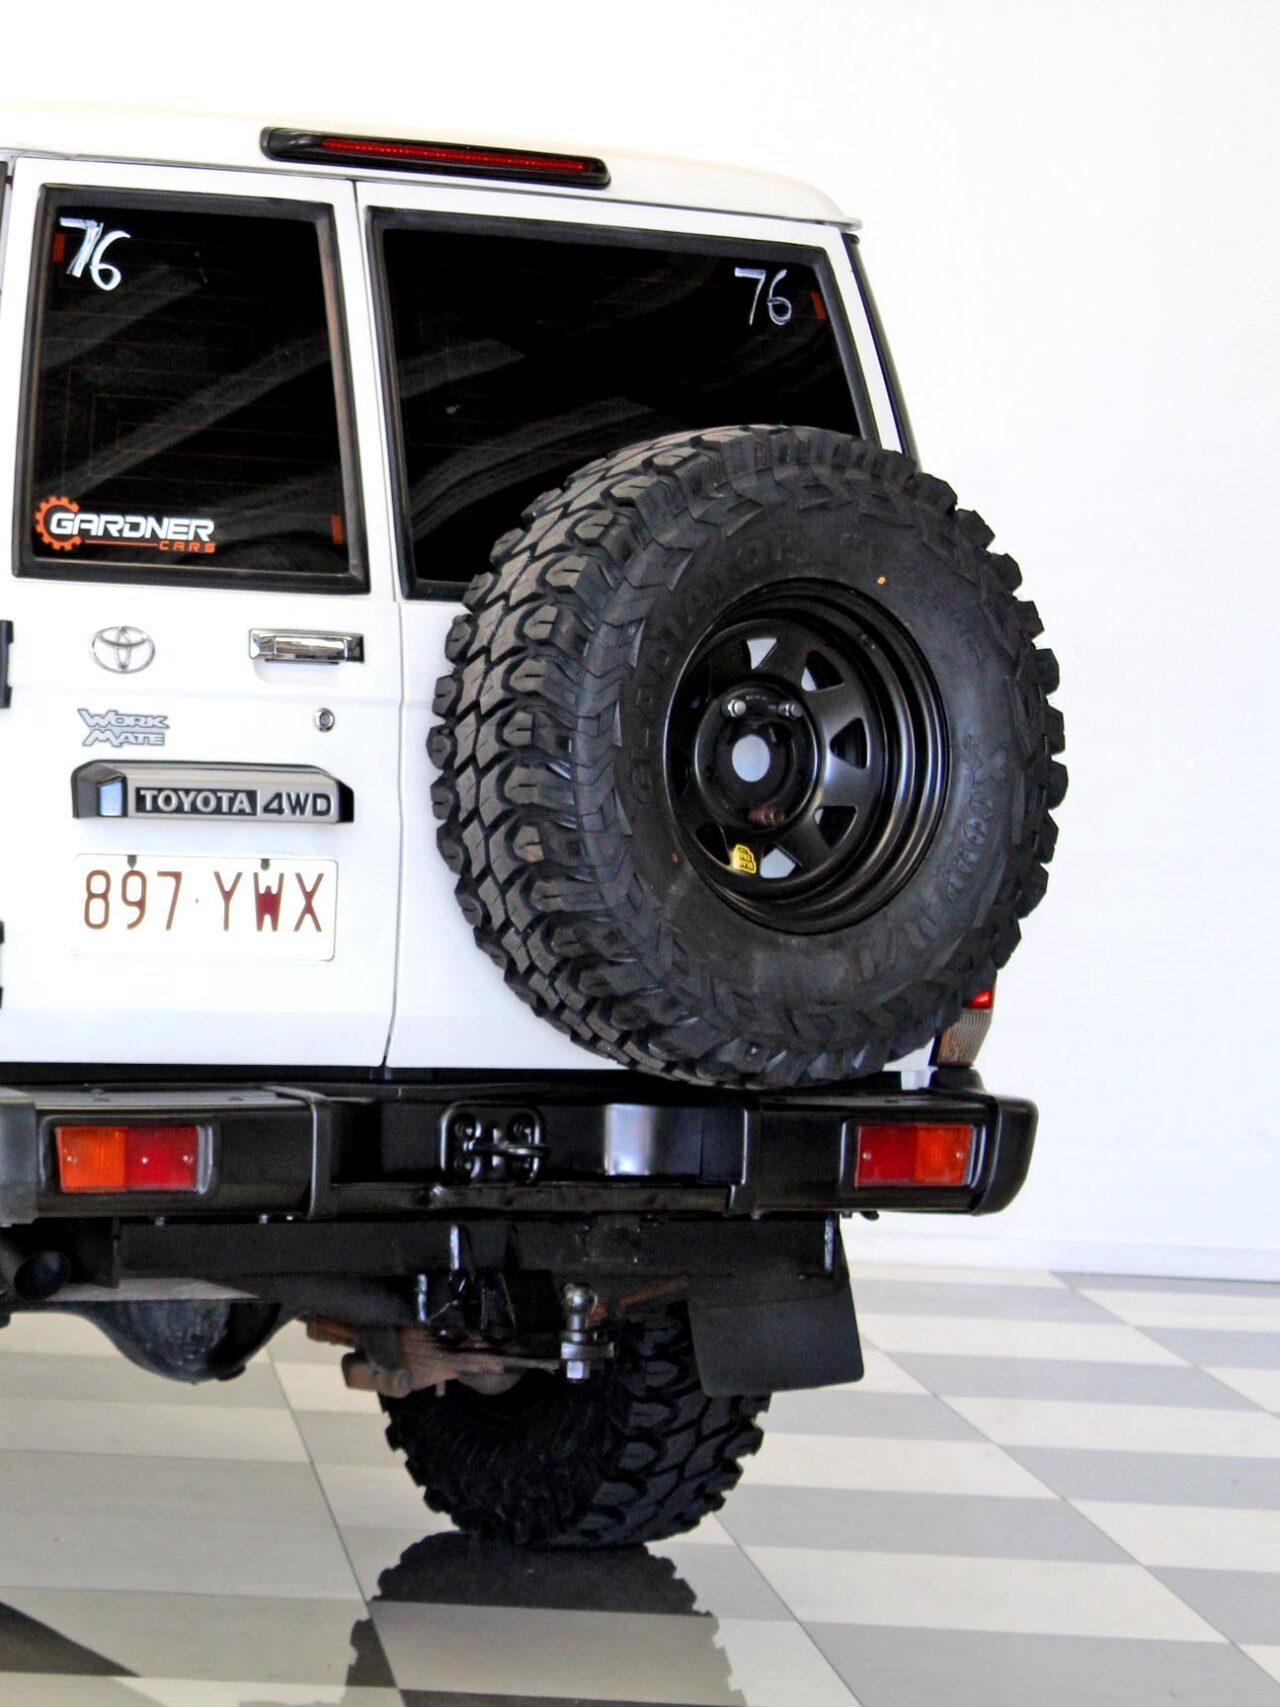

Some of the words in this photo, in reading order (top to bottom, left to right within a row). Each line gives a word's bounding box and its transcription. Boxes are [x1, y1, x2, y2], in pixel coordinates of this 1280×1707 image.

[59, 216, 131, 291] 76
[734, 266, 792, 326] 76
[49, 512, 215, 542] GARDNER
[158, 540, 217, 554] CARS
[77, 708, 170, 729] WORK
[81, 728, 166, 748] MATE
[139, 789, 253, 814] TOYOTA
[263, 792, 333, 817] 4WD
[83, 869, 183, 931] 897
[213, 871, 325, 932] YWX
